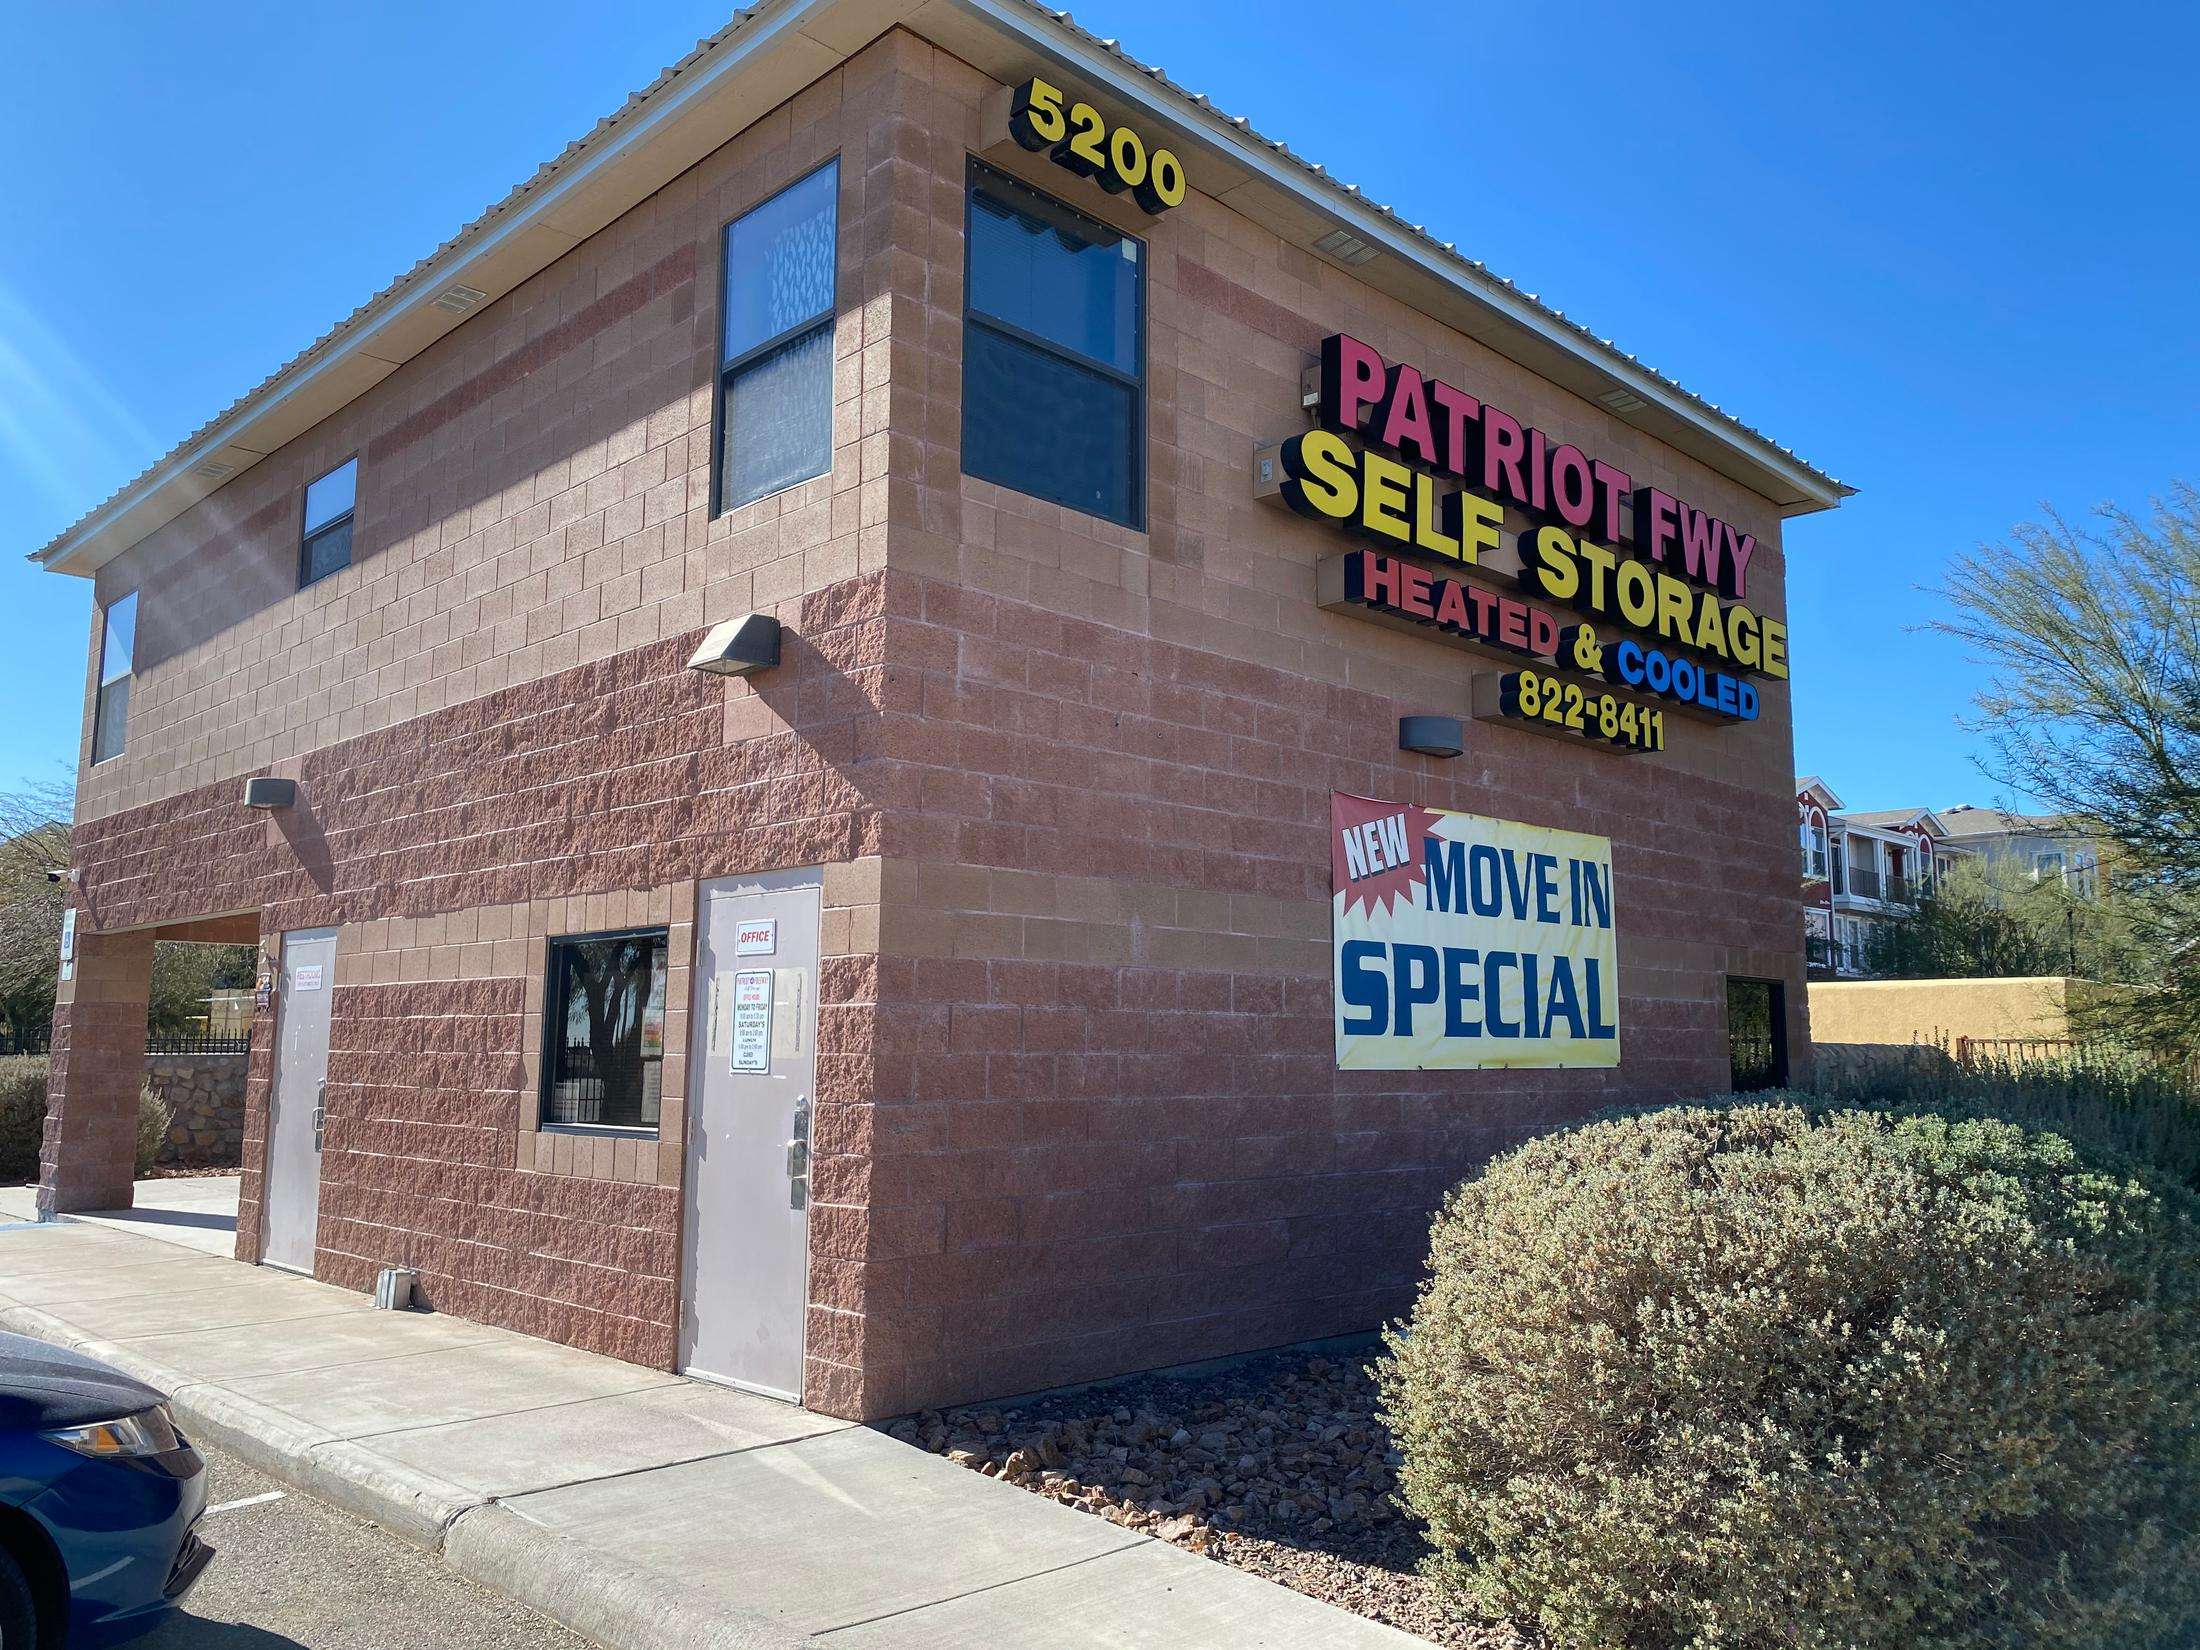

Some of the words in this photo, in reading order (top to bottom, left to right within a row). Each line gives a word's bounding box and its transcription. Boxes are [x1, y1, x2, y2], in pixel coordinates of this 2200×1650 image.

[1026, 76, 1187, 207] 5200
[1339, 332, 1632, 545] PATRIOT
[1650, 486, 1757, 599] FWY
[1299, 429, 1505, 567] SELF
[1536, 526, 1789, 680] STORAGE
[1362, 548, 1560, 658] HEATED
[1572, 622, 1603, 674] &
[1617, 639, 1761, 721] COOLED
[1517, 669, 1665, 752] 822-8411
[1341, 812, 1410, 882] NEW
[1423, 836, 1561, 925] MOVE
[1569, 857, 1612, 930] IN
[740, 930, 770, 944] OFFICE
[738, 1020, 765, 1029] SATURDAY'S
[1340, 938, 1617, 1040] SPECIAL
